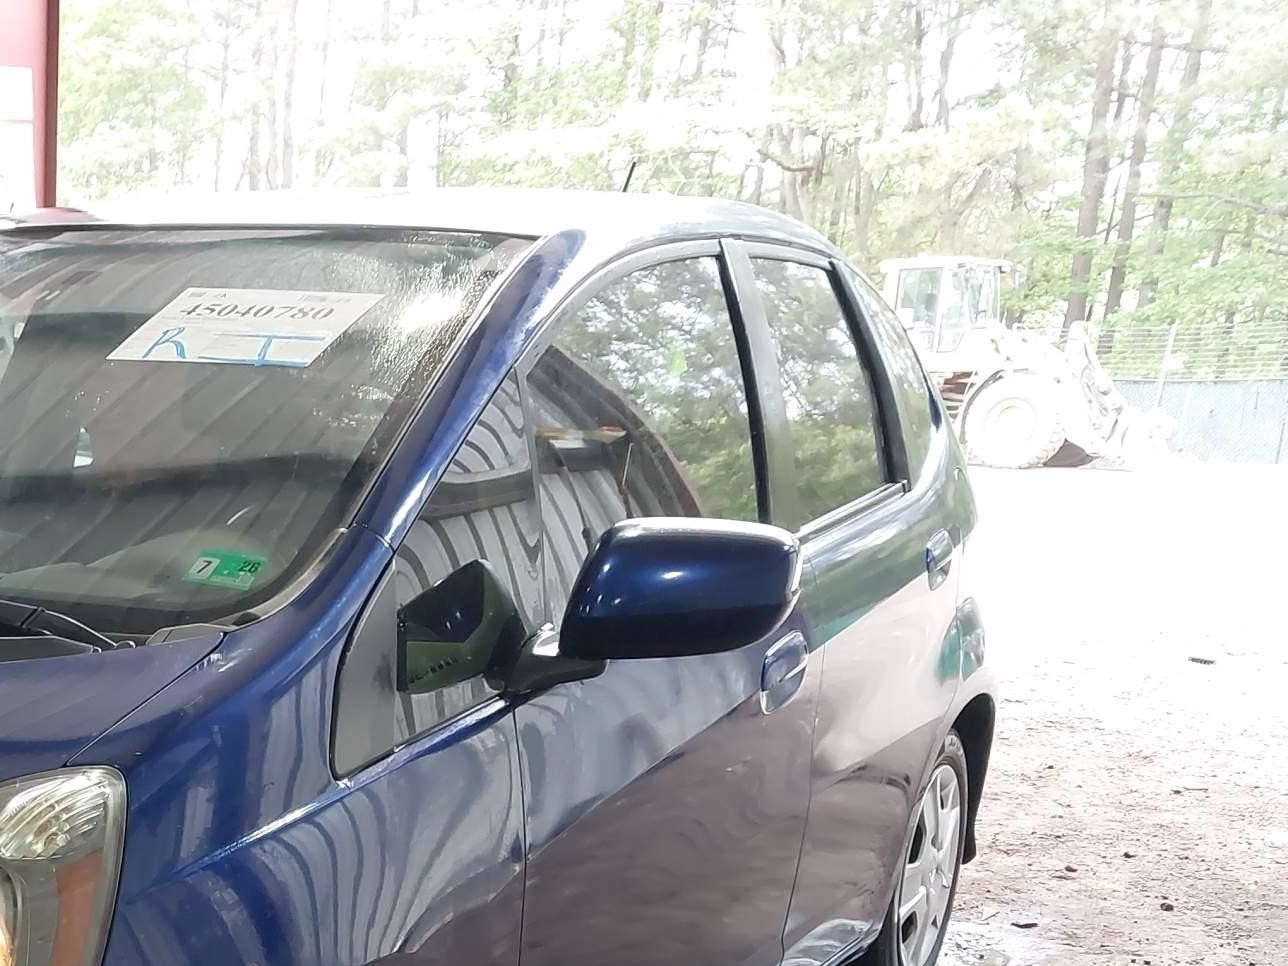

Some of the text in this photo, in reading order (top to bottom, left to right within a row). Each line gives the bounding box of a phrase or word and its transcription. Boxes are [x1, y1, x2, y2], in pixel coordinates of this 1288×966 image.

[180, 302, 335, 321] 45040780
[141, 326, 186, 359] R
[196, 560, 261, 574] 7 26
